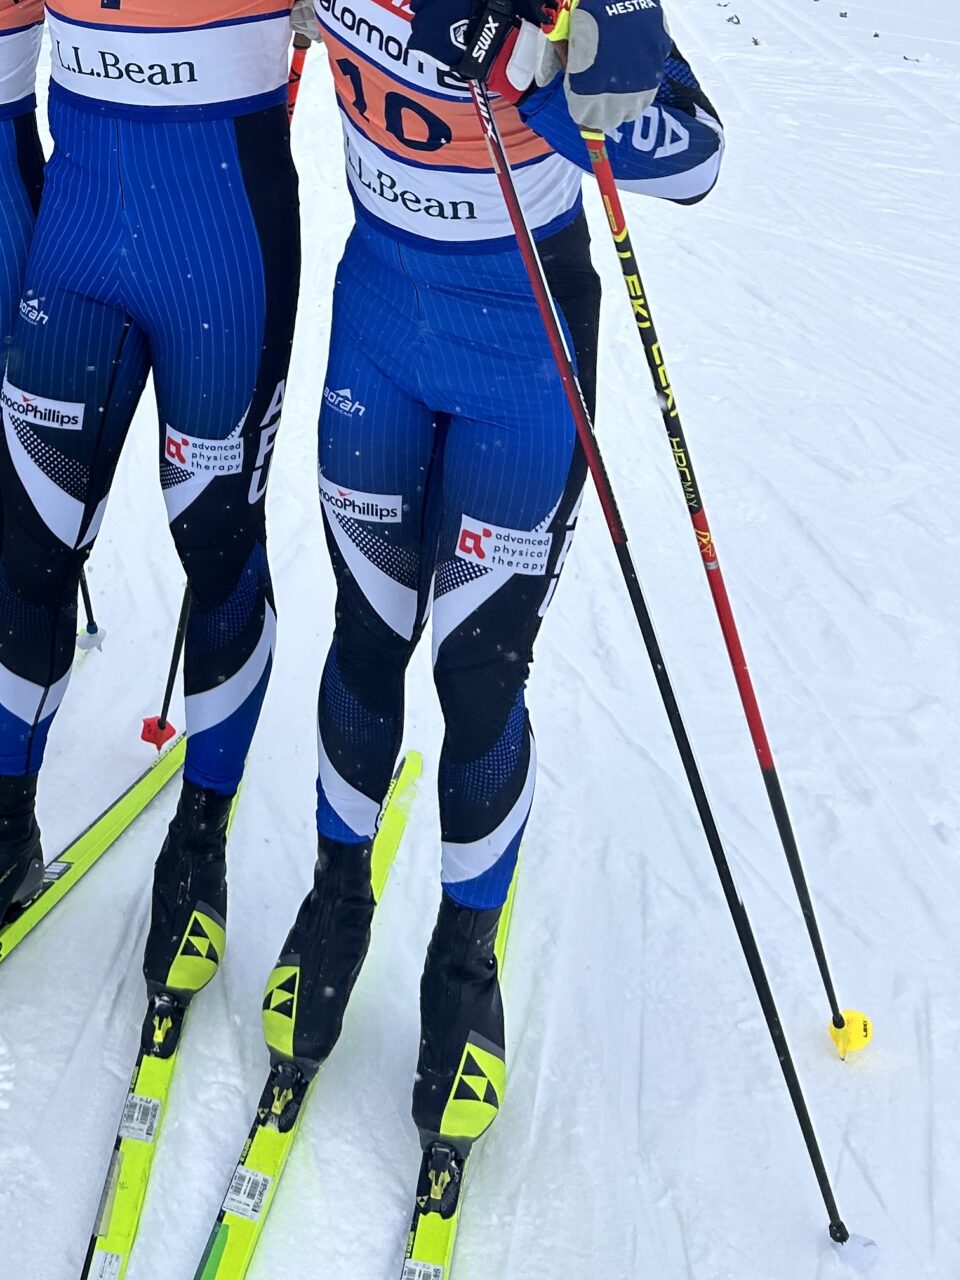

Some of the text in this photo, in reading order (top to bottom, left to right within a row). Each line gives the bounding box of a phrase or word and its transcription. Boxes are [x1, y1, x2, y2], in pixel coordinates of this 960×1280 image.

[472, 15, 500, 63] SWIX
[336, 57, 453, 152] 10
[191, 442, 241, 451] advanced
[191, 451, 241, 462] physical
[191, 461, 241, 472] therapy
[495, 532, 550, 546] advanced
[493, 543, 548, 558] physical
[491, 555, 545, 571] therapy
